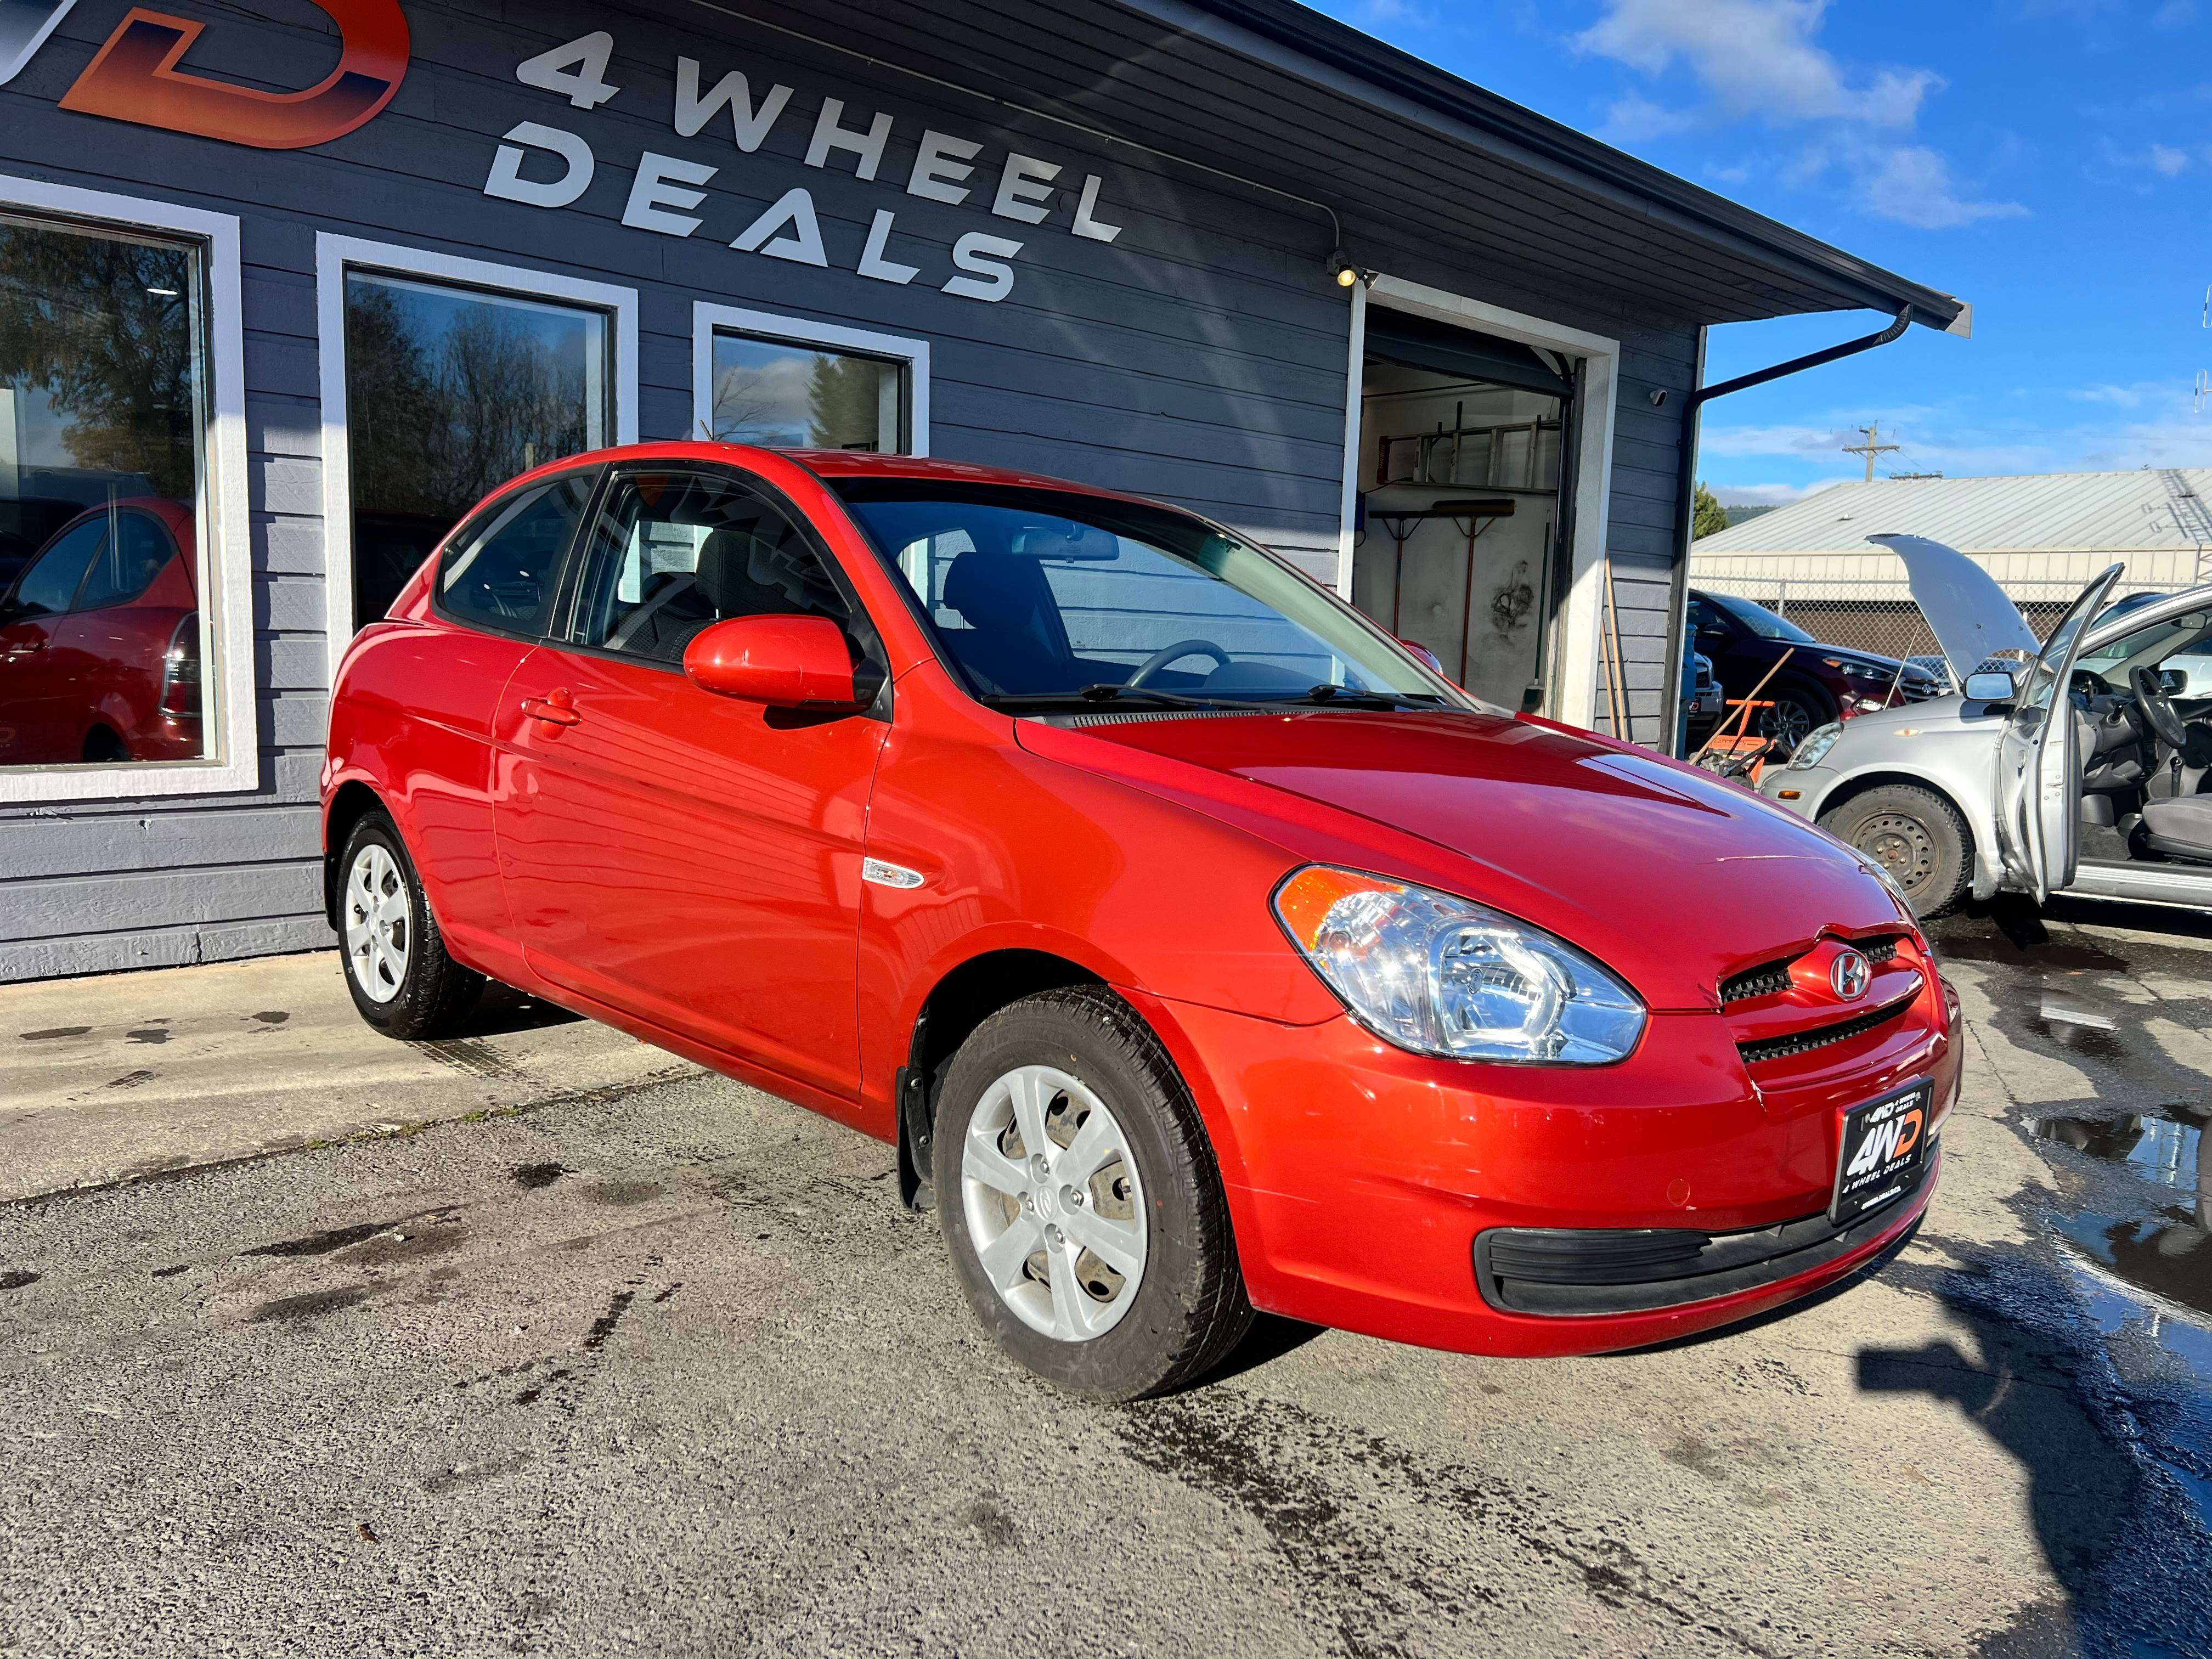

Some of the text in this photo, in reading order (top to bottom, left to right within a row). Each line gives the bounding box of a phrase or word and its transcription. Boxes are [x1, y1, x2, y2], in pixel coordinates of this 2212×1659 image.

[483, 121, 1025, 302] DEALS
[516, 31, 1122, 242] 4 WHEEL
[1851, 1170, 1881, 1190] WHEEL
[1883, 1154, 1912, 1175] DEALS
